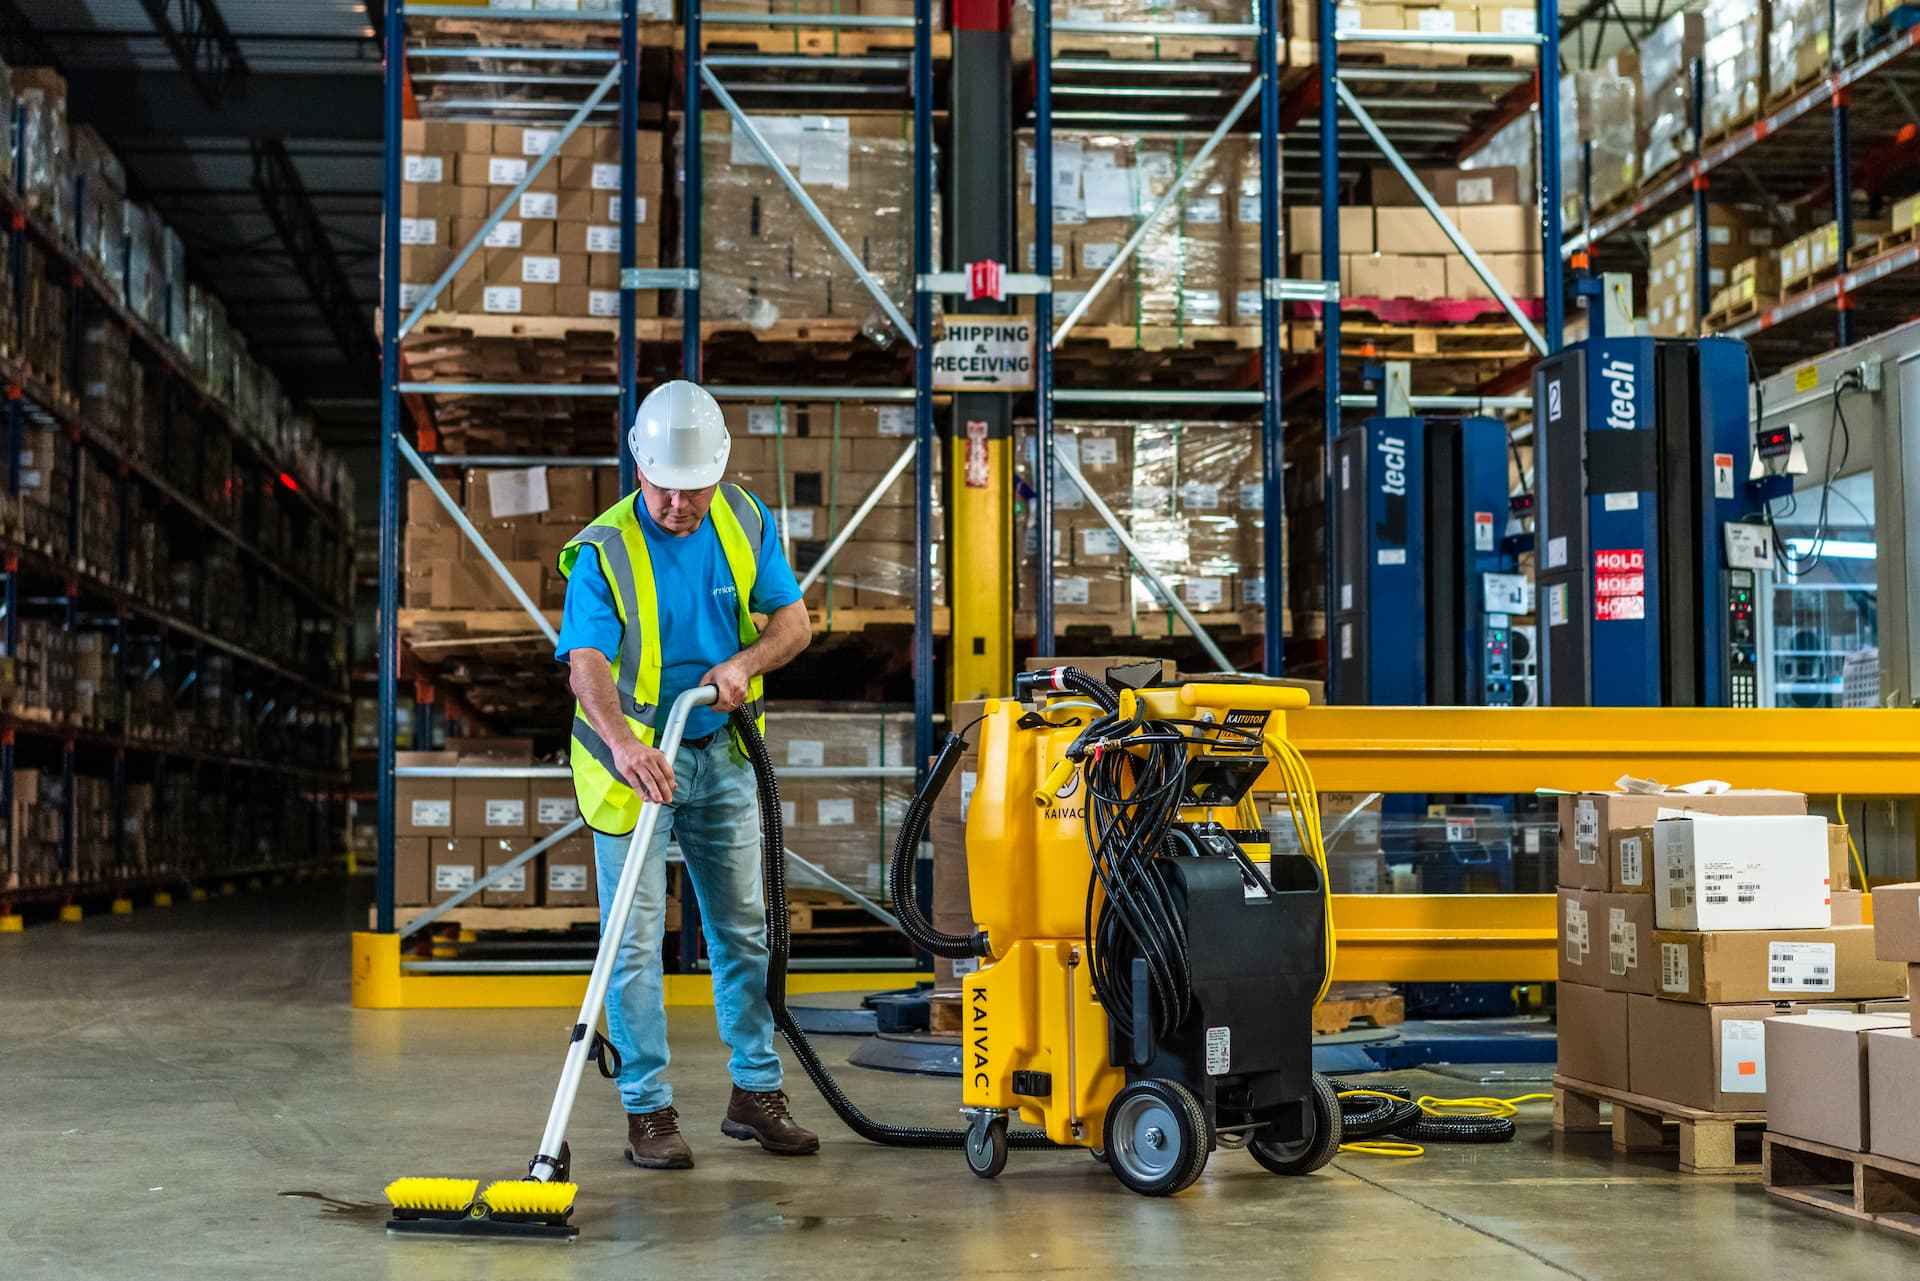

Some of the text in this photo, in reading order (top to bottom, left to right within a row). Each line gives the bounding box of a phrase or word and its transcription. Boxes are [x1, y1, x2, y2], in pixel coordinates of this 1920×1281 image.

[943, 326, 1030, 342] HIPPING
[975, 344, 987, 353] &
[935, 356, 1030, 372] RECEIVING
[1550, 385, 1560, 416] 2
[1602, 360, 1636, 431] tech
[1377, 437, 1406, 496] tech
[1596, 554, 1643, 569] HOLD
[1226, 713, 1265, 724] KAITUTOR
[1045, 808, 1086, 819] KAIVAC
[972, 988, 989, 1088] KAIVAC
